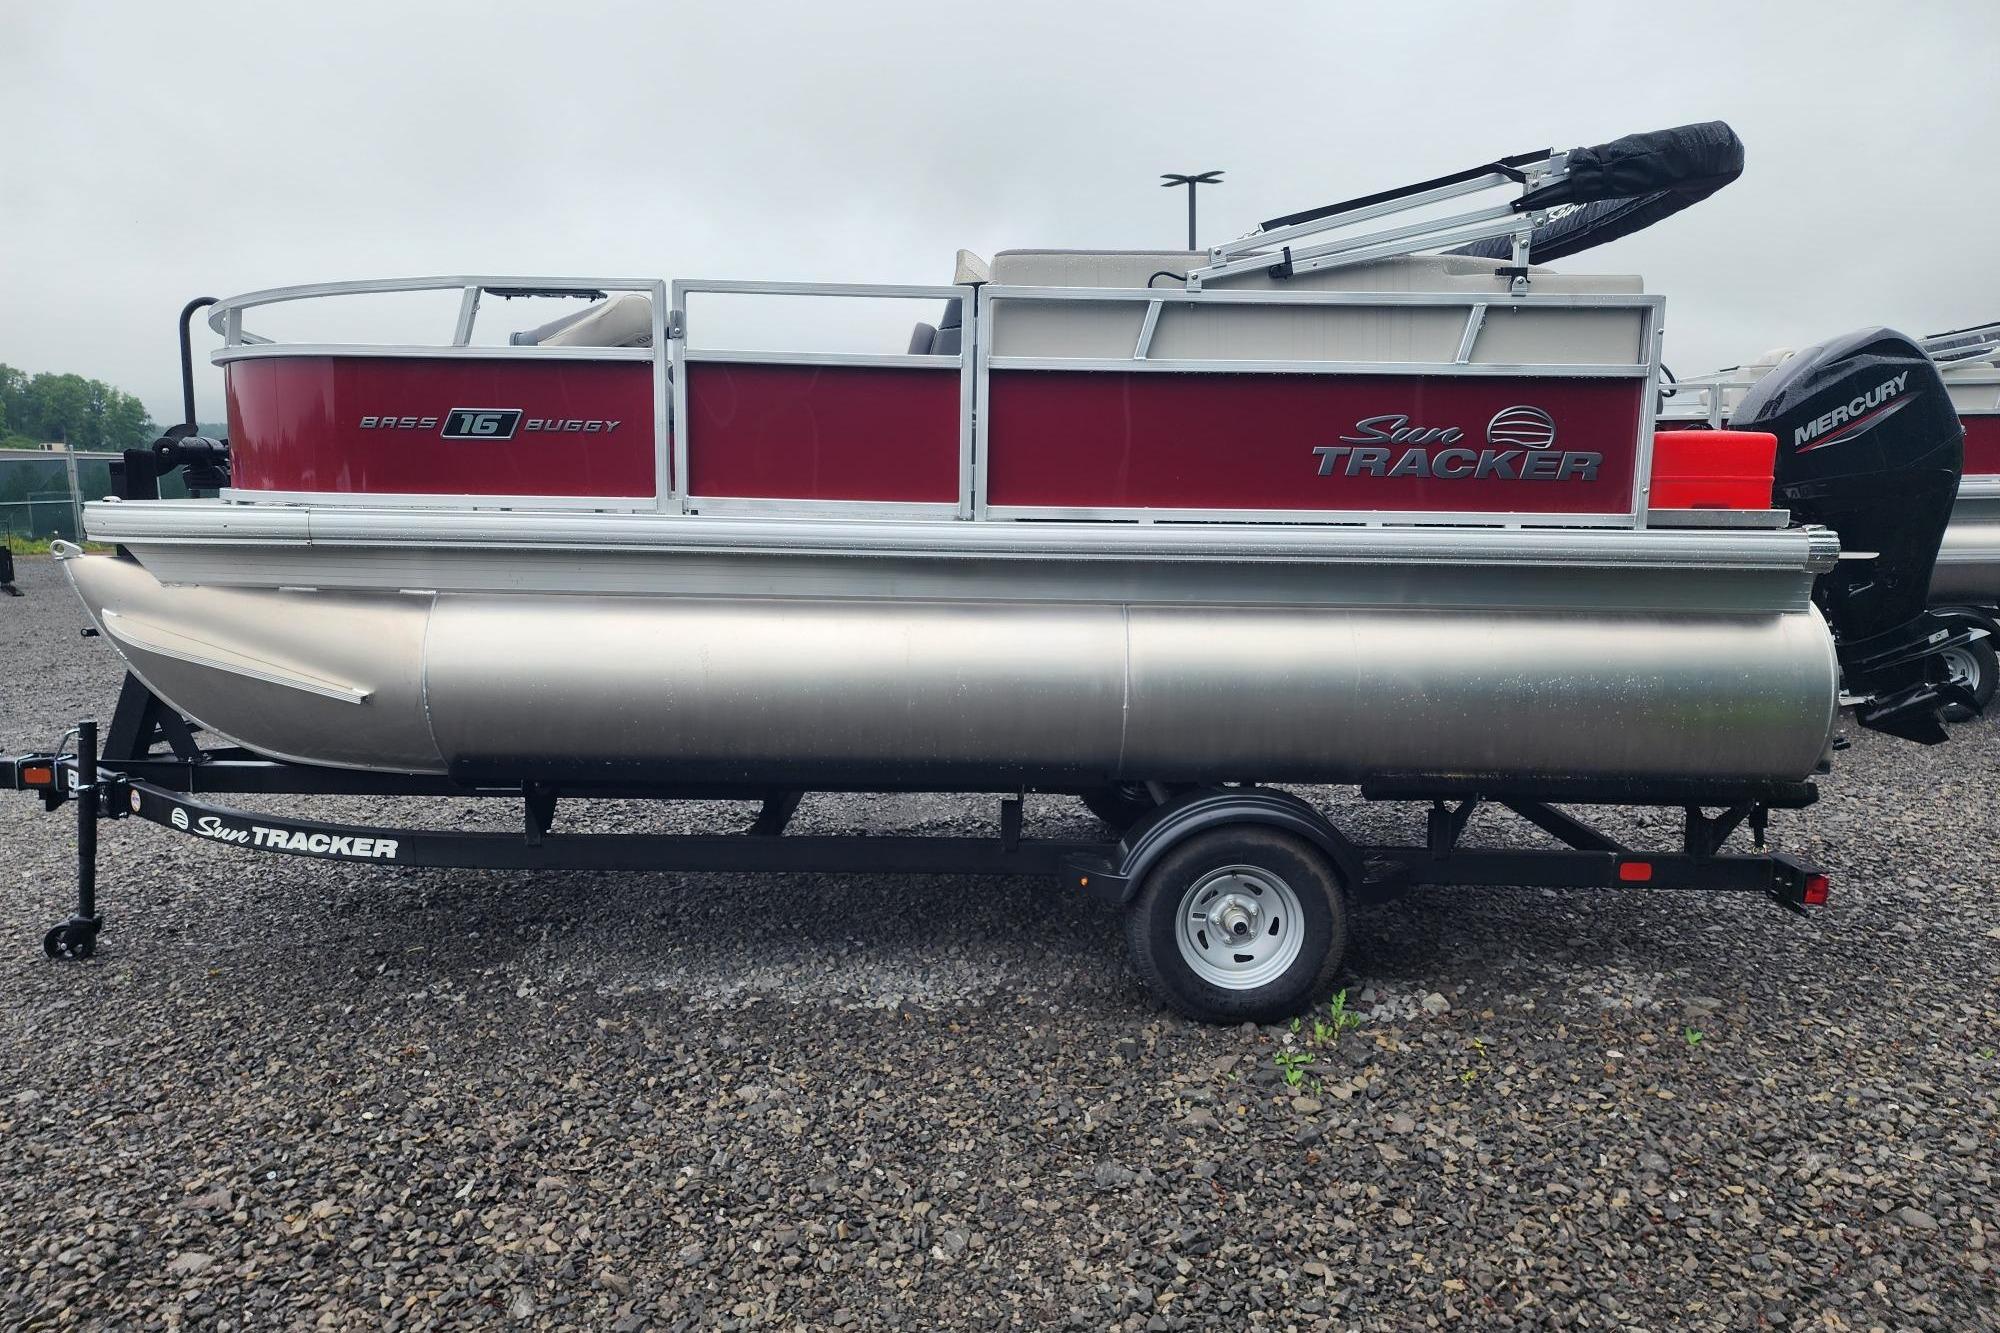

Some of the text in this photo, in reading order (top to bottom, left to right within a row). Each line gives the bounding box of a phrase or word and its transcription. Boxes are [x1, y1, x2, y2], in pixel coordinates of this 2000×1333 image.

[359, 413, 622, 435] BASS 16 BUGGY
[1794, 370, 1909, 447] MERCURY
[1339, 414, 1465, 445] Sun
[1312, 446, 1603, 481] TRACKER
[193, 816, 399, 859] Sun TRACKER
